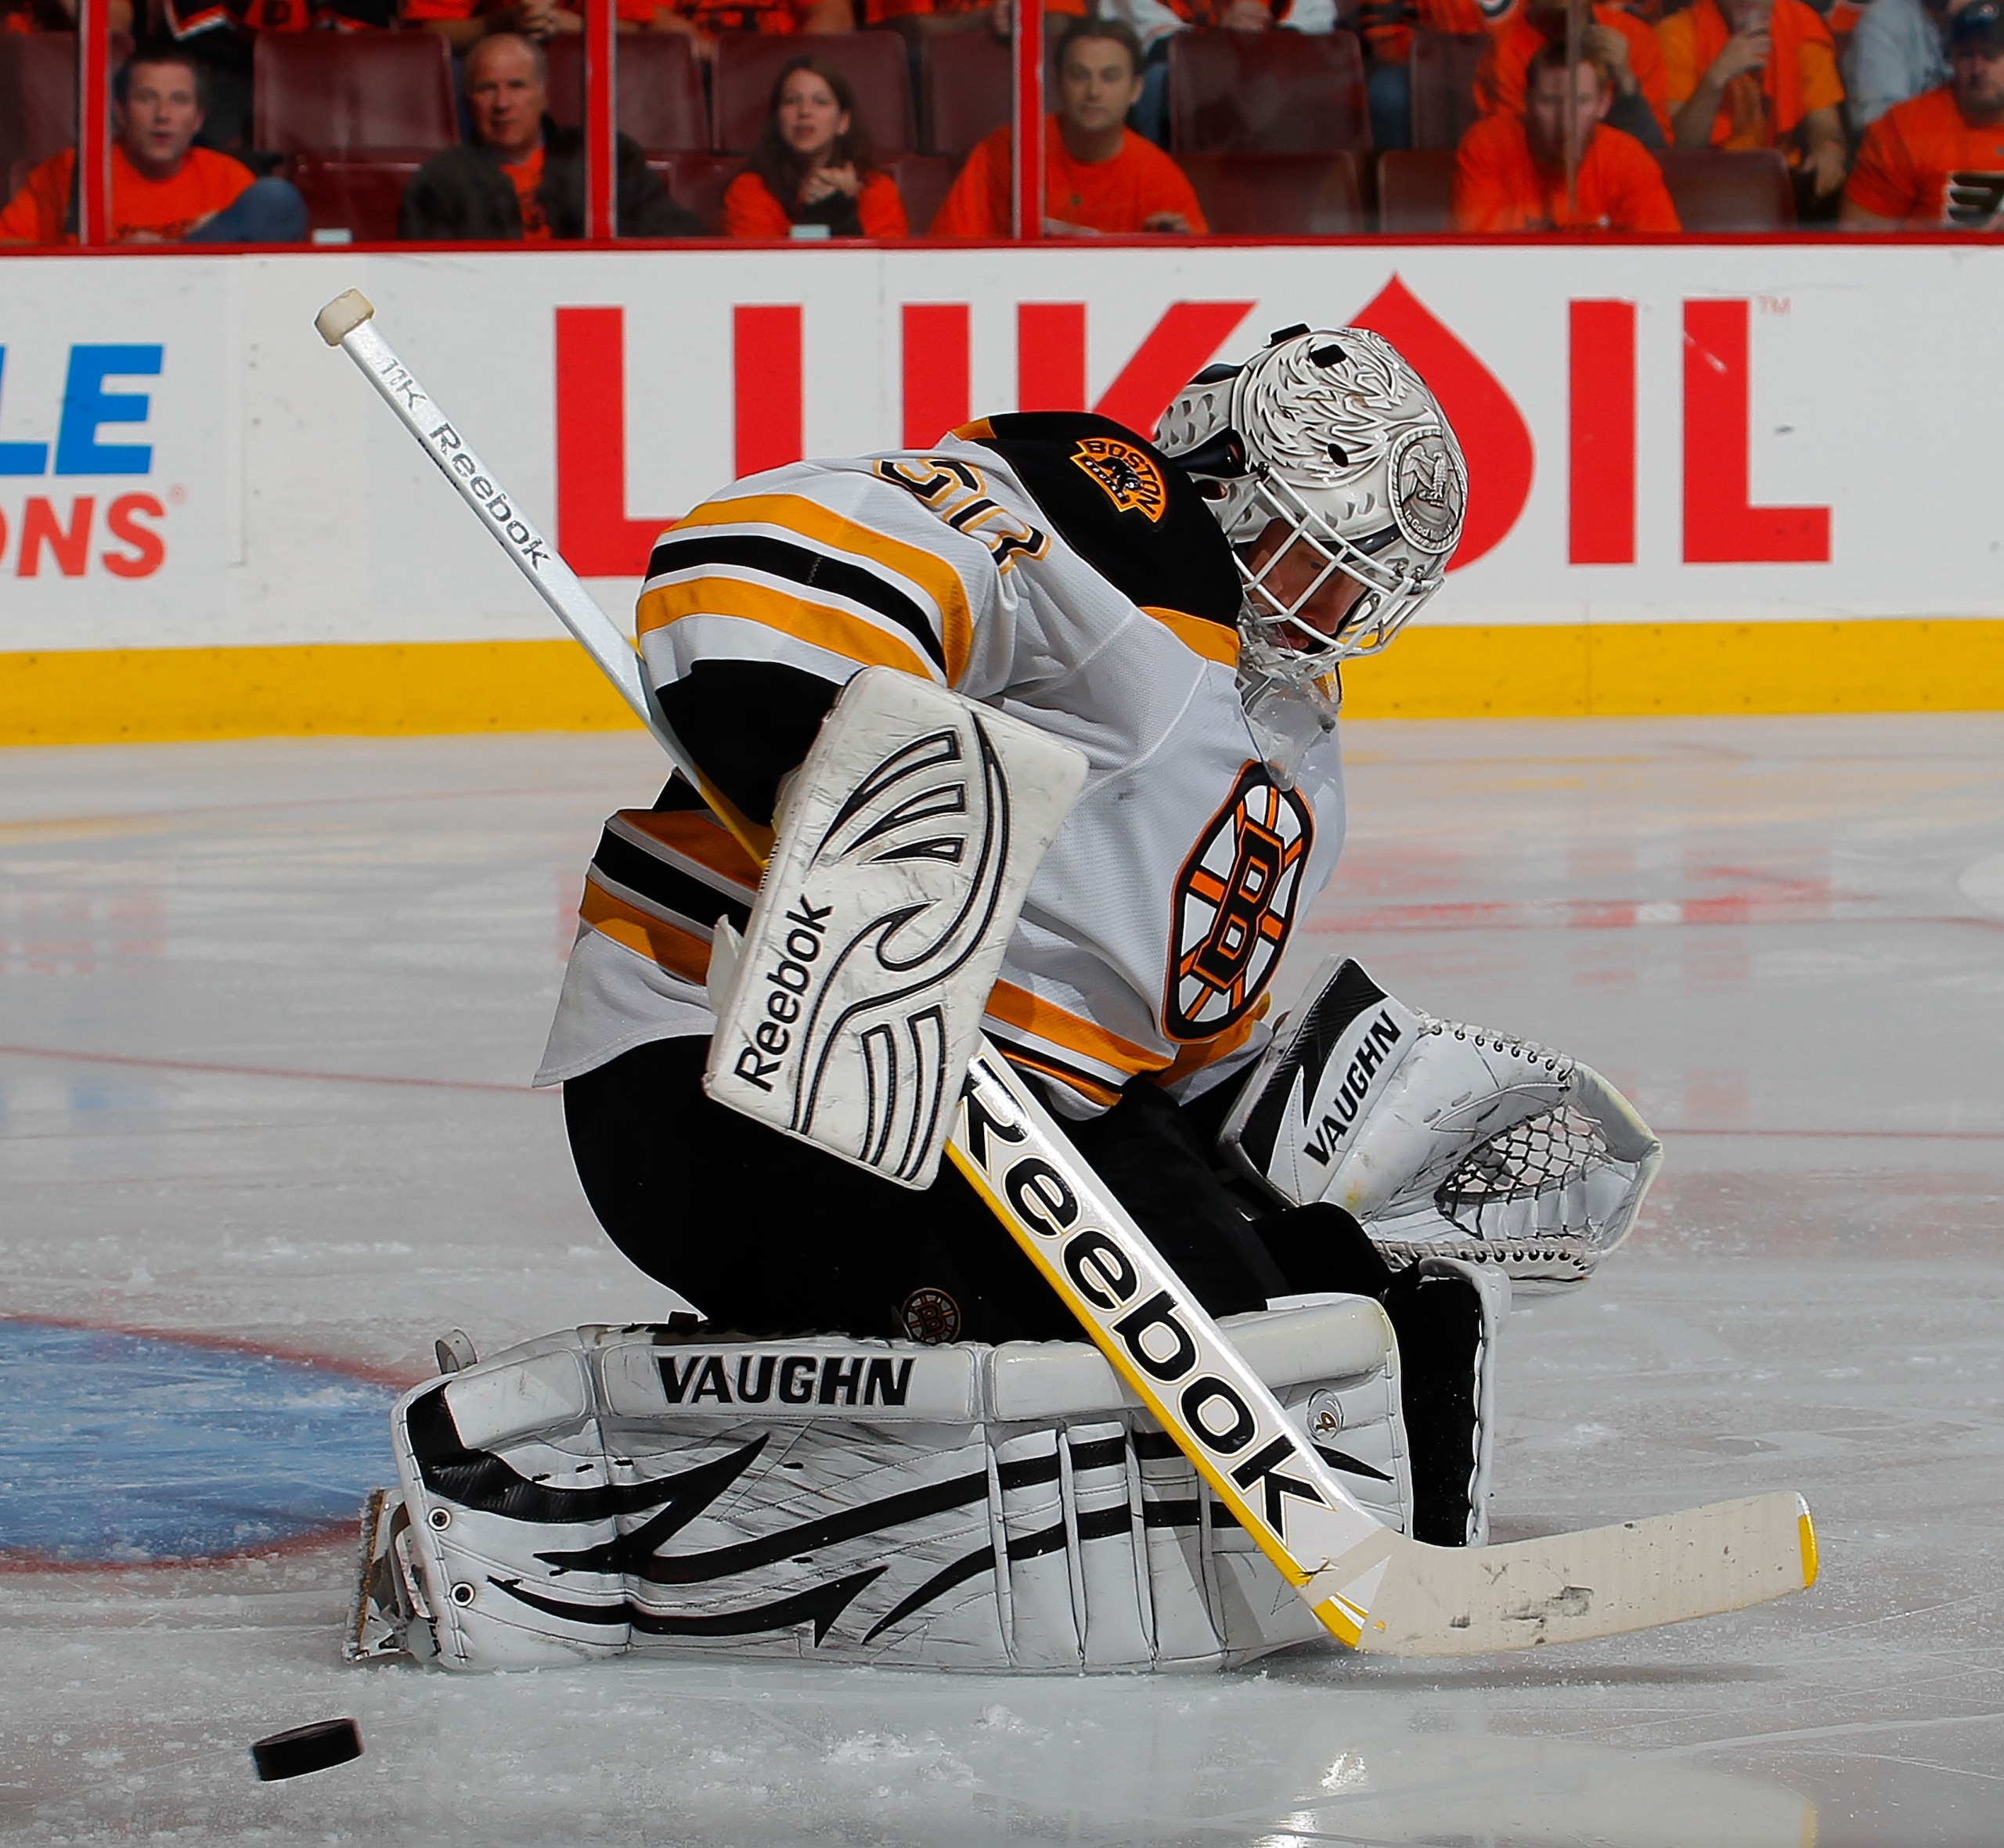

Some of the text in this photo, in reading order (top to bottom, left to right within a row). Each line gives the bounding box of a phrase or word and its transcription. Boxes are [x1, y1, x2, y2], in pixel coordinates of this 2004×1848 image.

[0, 491, 164, 578] NS
[429, 423, 551, 570] Reebok
[1083, 440, 1161, 515] BOSTON
[733, 893, 834, 1092] Reebok
[1303, 1010, 1402, 1167] VAUGHN
[958, 1054, 1335, 1550] Reebok
[657, 1355, 914, 1407] VAUGHN
